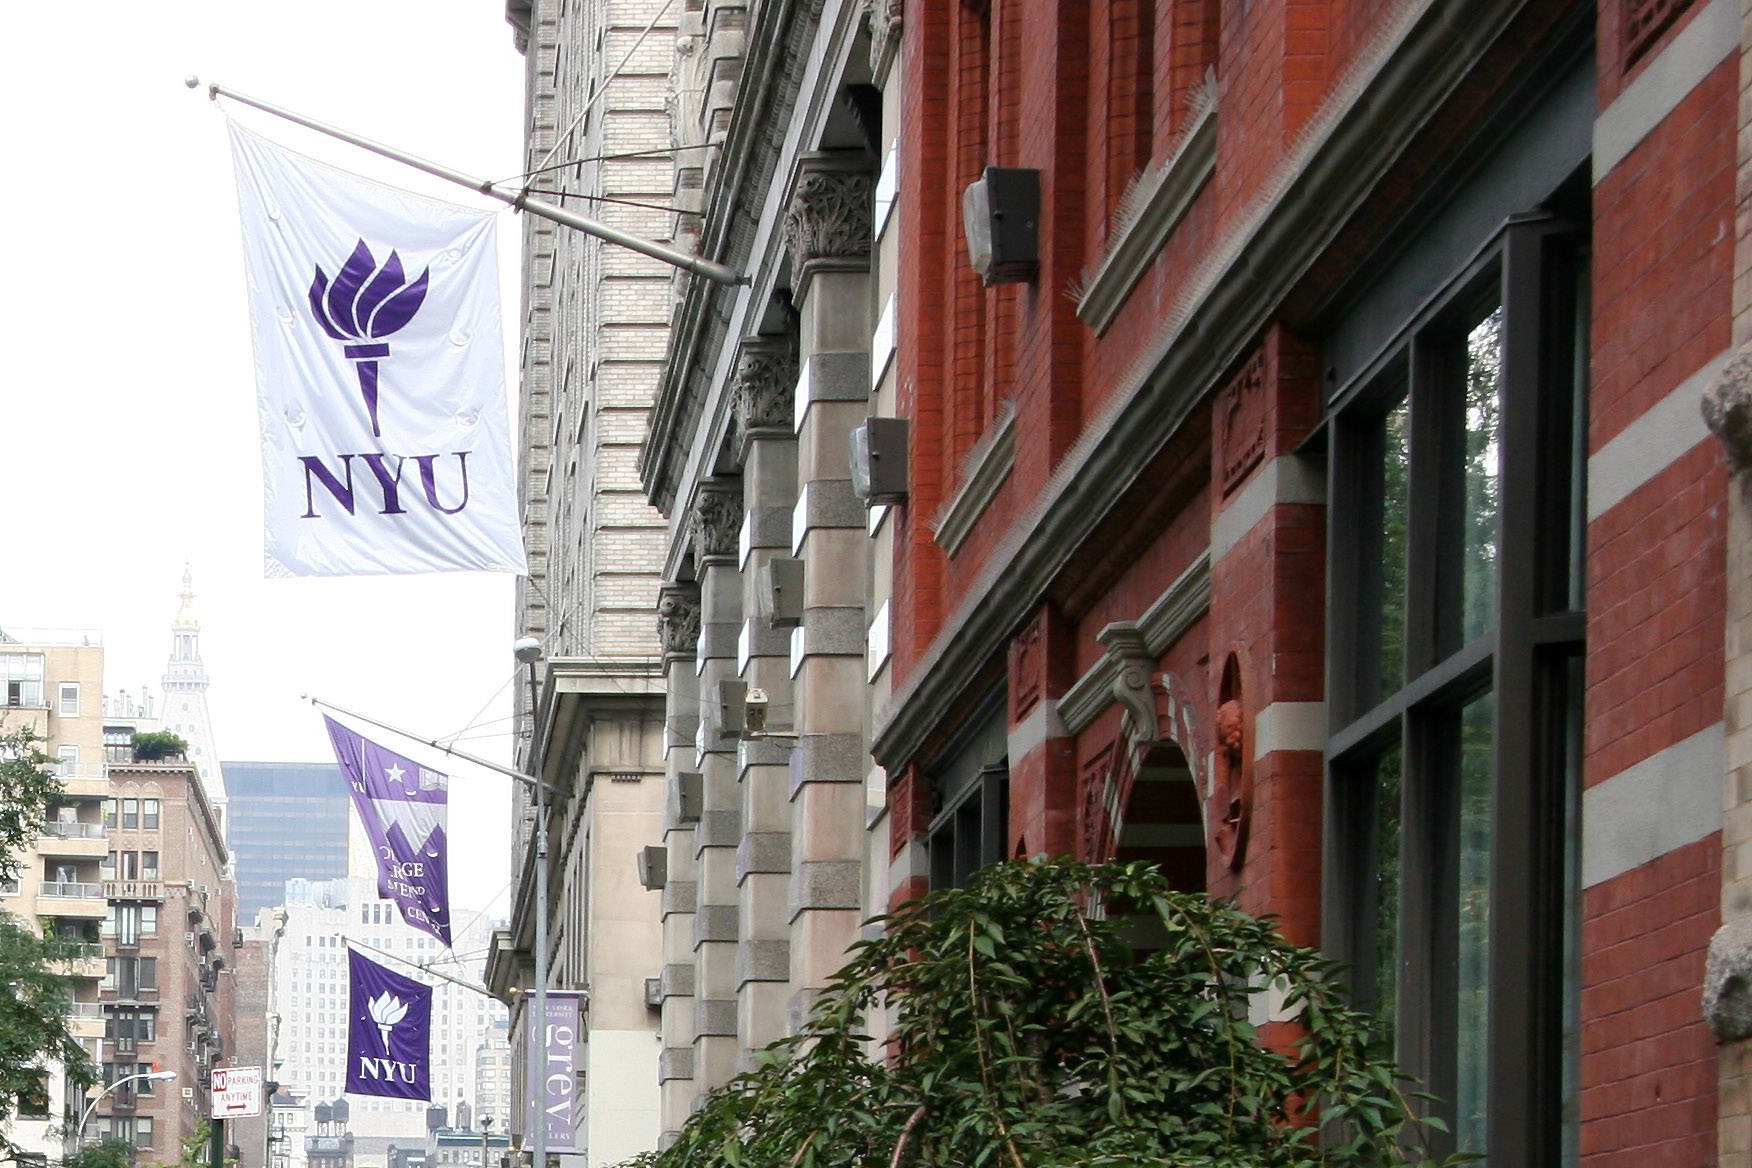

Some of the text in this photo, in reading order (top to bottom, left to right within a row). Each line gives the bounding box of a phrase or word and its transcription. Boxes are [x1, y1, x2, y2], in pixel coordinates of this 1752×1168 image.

[297, 451, 473, 518] NYU
[213, 1072, 226, 1090] NO
[359, 1056, 417, 1084] NYU
